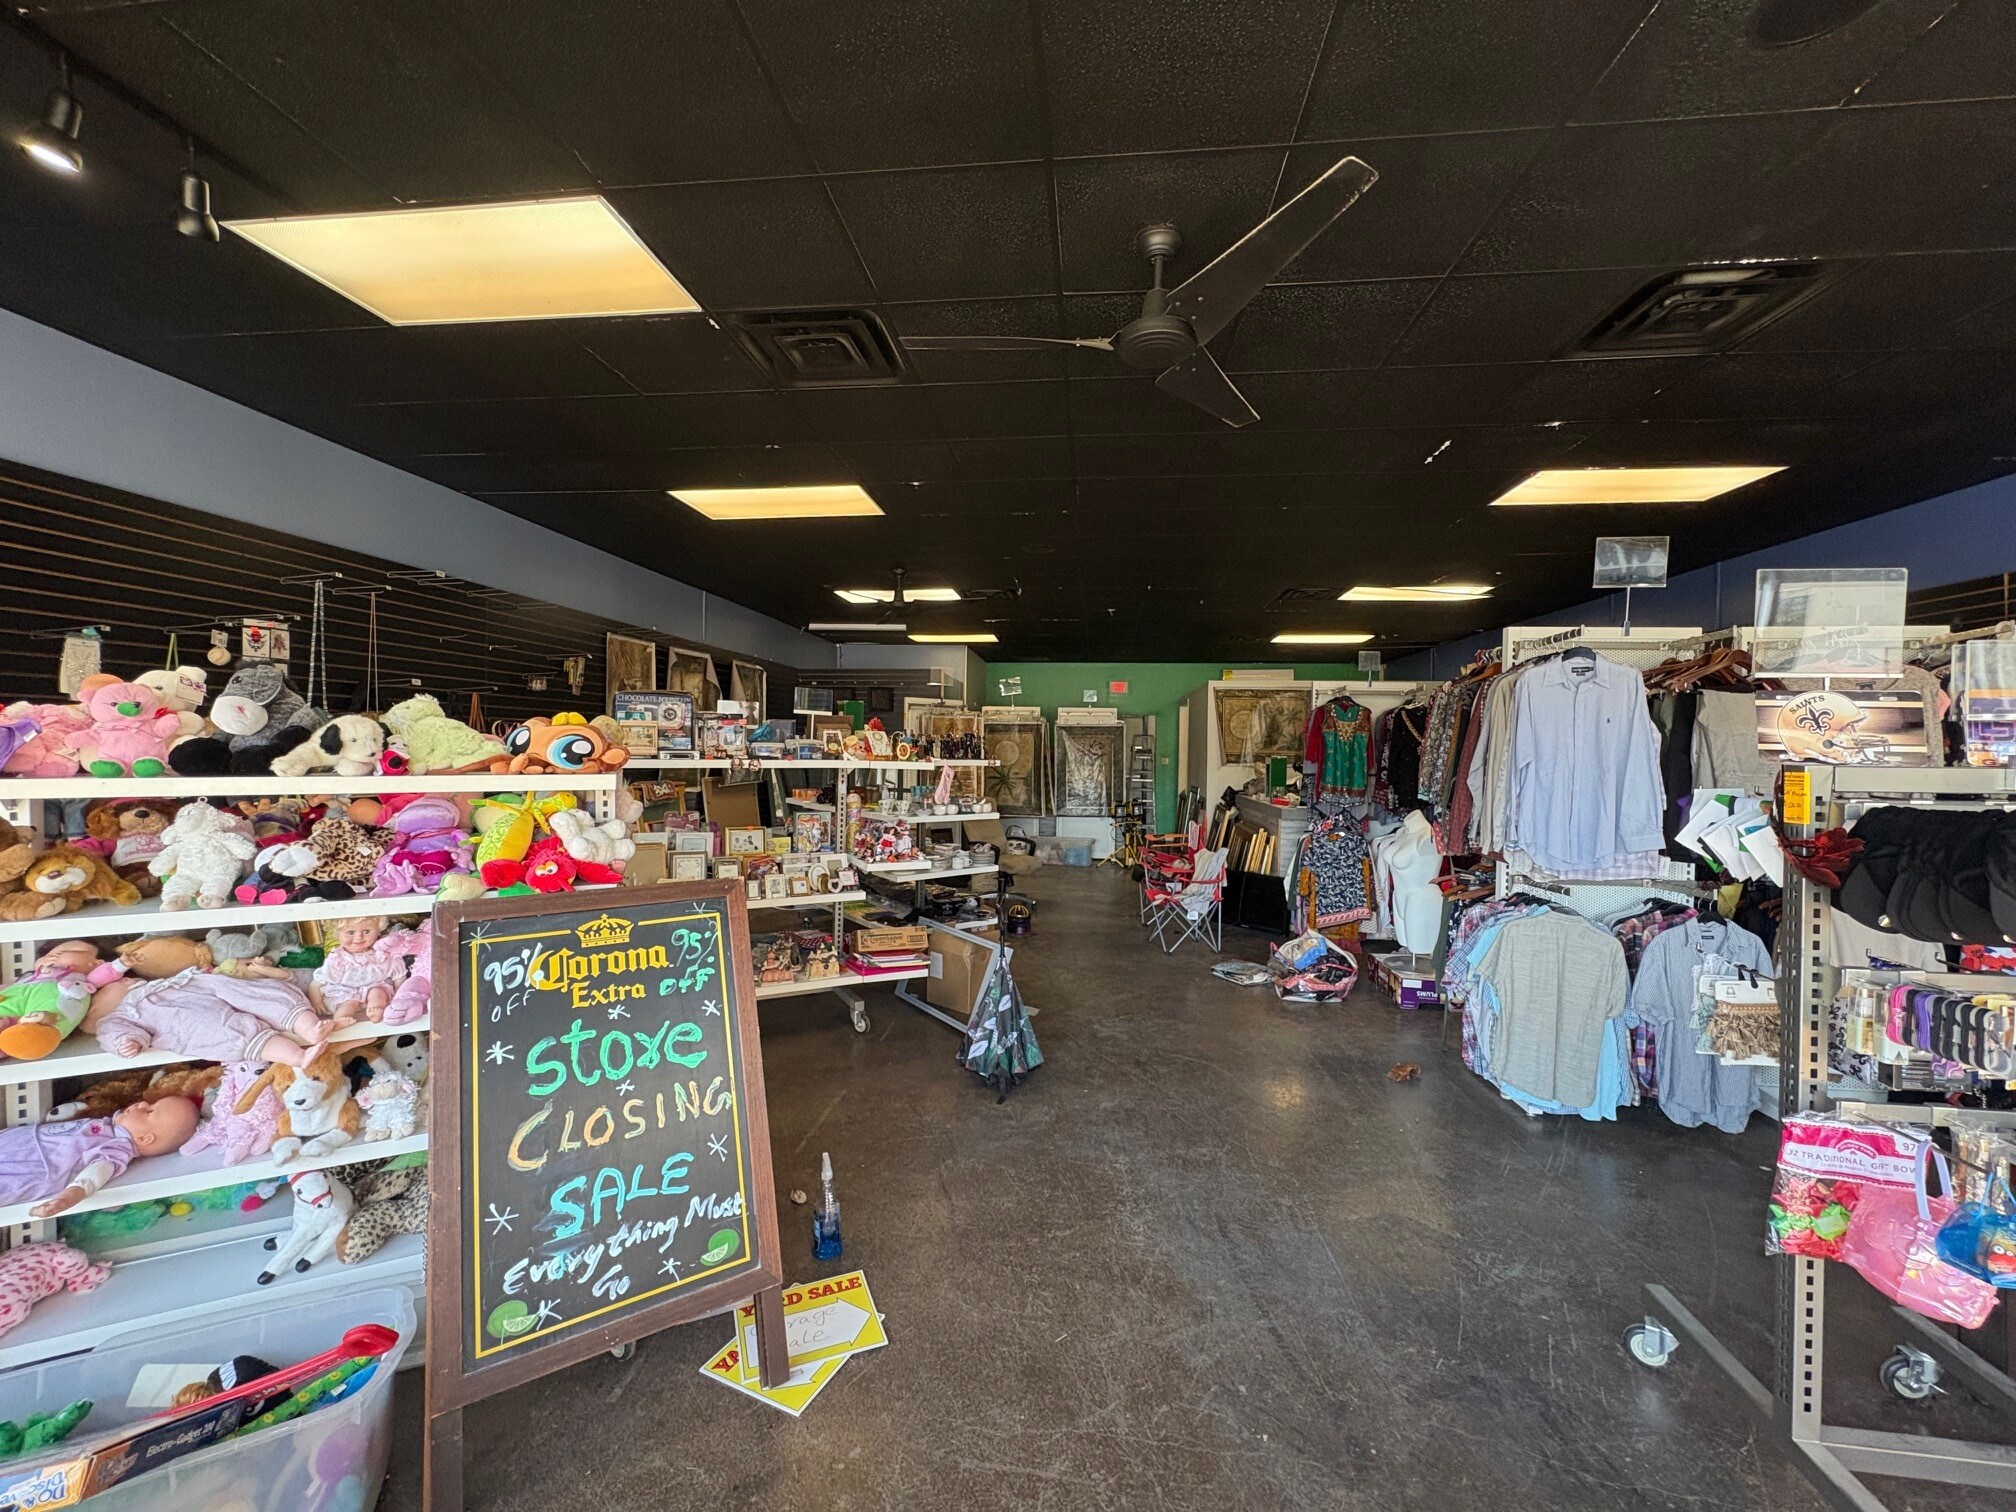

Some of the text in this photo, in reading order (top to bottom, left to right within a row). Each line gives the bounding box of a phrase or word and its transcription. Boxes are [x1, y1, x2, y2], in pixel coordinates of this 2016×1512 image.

[616, 693, 692, 703] CHOCOLATE FOUNTAIN
[1789, 694, 1826, 714] SAINTS
[870, 934, 904, 943] Copenhagen
[484, 943, 545, 995] 95%
[530, 945, 672, 993] Corona
[571, 981, 647, 1009] Extra
[508, 1075, 733, 1173] CLOSING
[1787, 1148, 1798, 1157] 32
[1802, 1151, 1866, 1167] TRADITIONAL
[548, 1152, 695, 1241] SALE
[591, 1264, 632, 1301] Go
[739, 1276, 863, 1318] YD SALE
[789, 1328, 831, 1349] ale
[38, 1484, 66, 1503] DO
